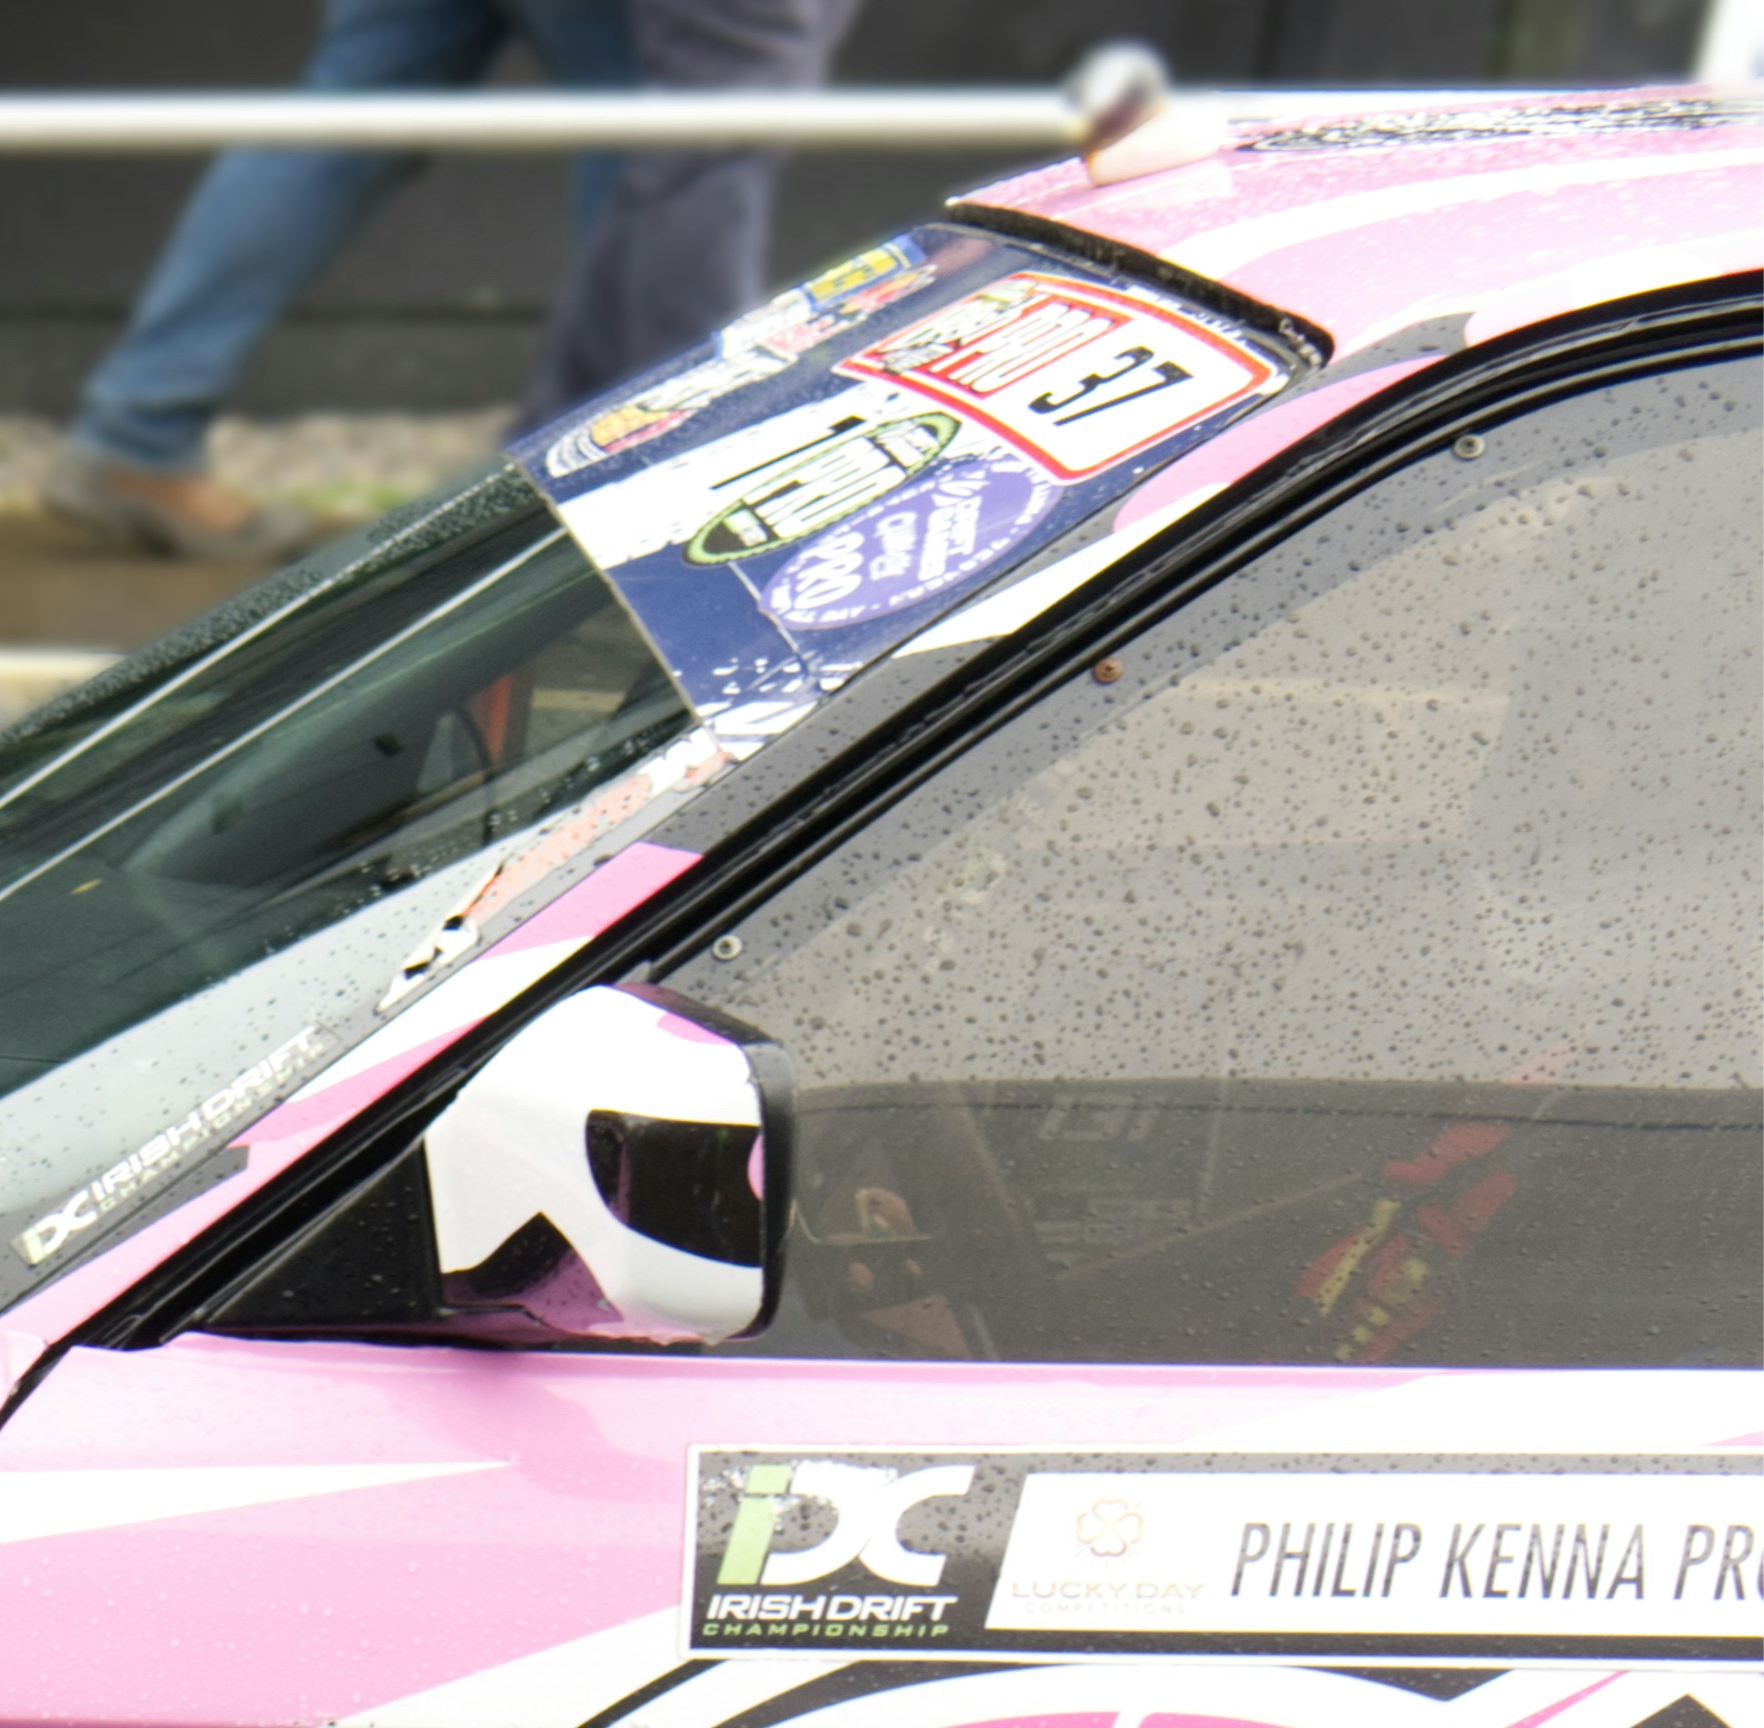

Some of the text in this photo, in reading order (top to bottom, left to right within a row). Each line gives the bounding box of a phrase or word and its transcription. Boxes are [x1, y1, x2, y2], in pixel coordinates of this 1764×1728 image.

[1028, 345, 1194, 427] 37
[742, 436, 907, 538] PRO
[794, 532, 865, 609] PRO
[93, 1110, 203, 1202] IRISH
[200, 1023, 322, 1124] DRIFT
[1012, 1580, 1206, 1601] LUCKY DAY
[1230, 1521, 1764, 1601] PHILIP KENNA PR
[702, 1622, 949, 1638] CHAMPIONSHIP
[706, 1594, 959, 1622] IRISH DRIFT
[1024, 1602, 1187, 1616] COMPETITIONS
